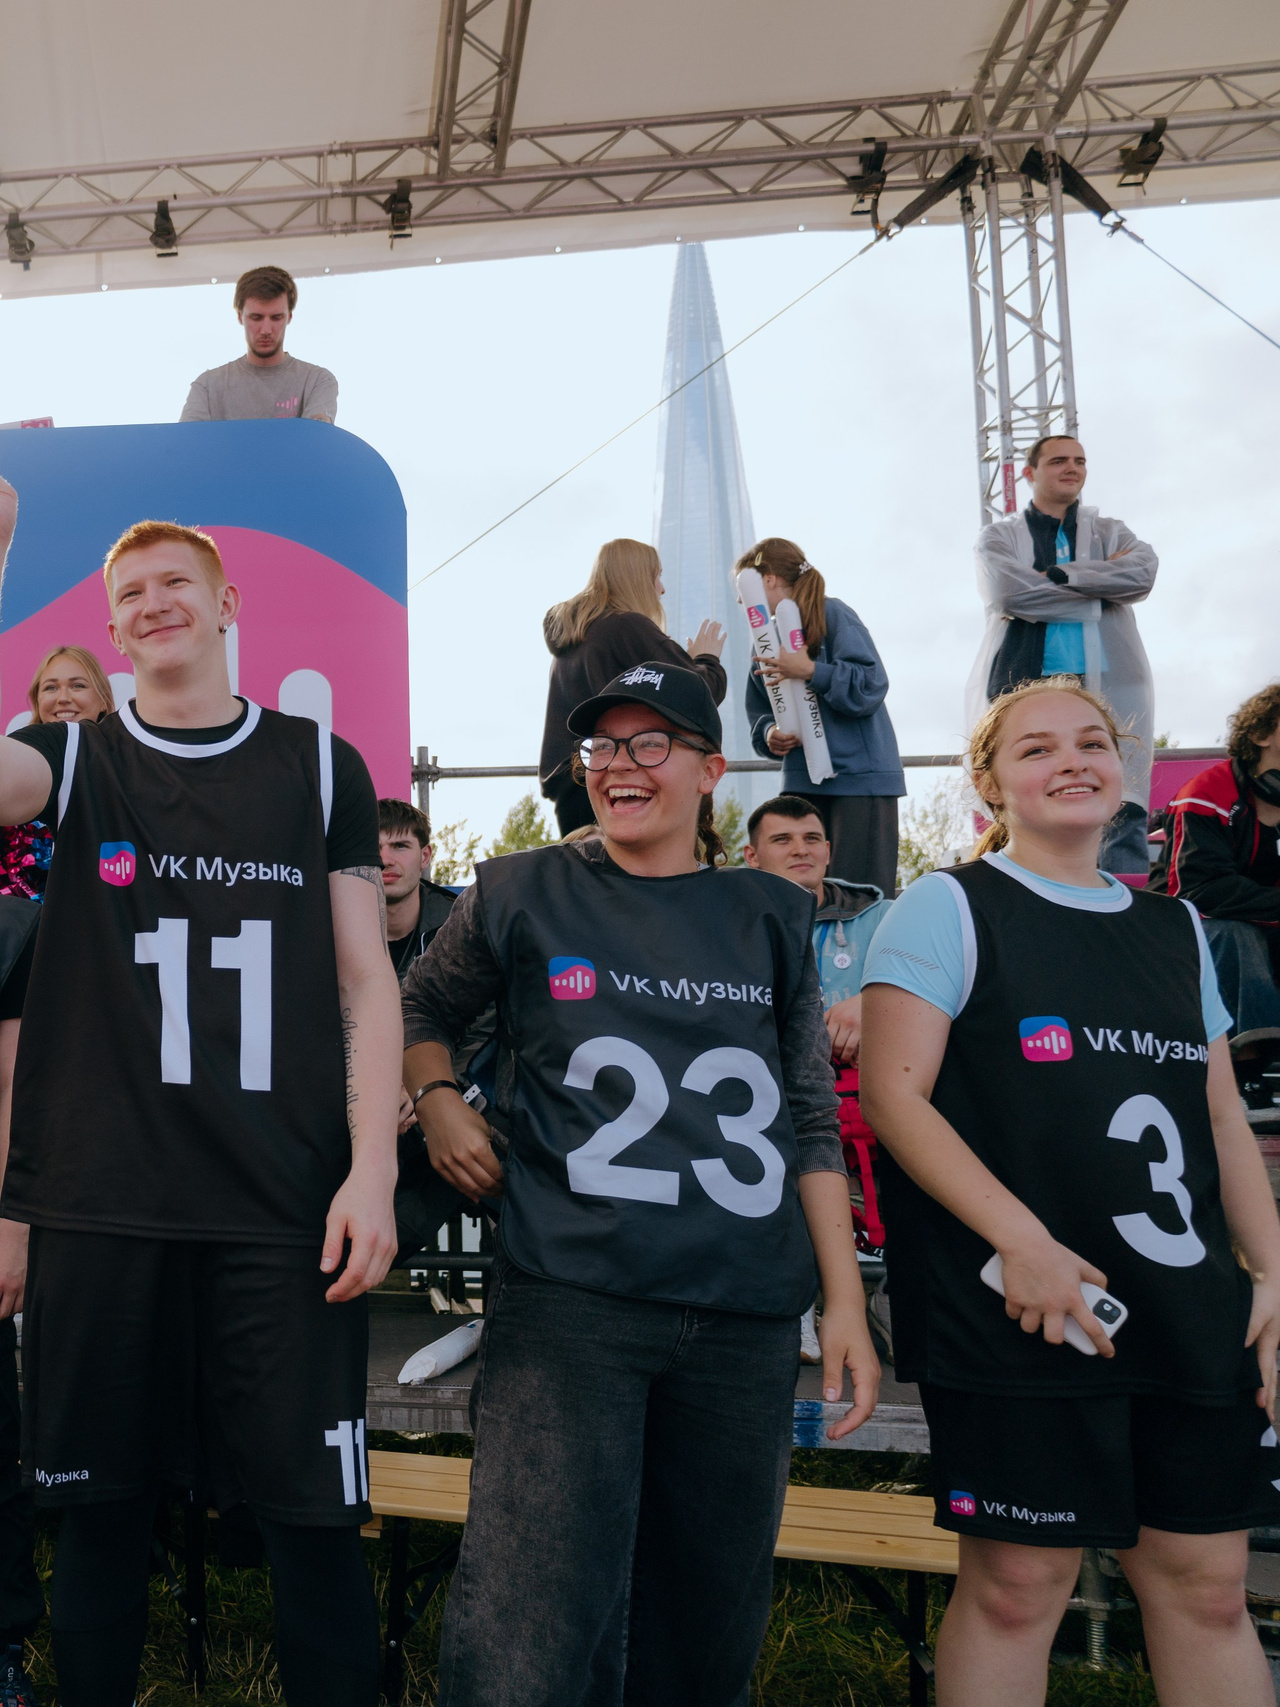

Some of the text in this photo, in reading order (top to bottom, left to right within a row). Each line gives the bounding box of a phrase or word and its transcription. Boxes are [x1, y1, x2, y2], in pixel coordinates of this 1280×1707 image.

[757, 632, 773, 654] VK
[148, 853, 303, 887] VK Музыка
[134, 917, 272, 1091] 11
[608, 970, 773, 1007] VK Музыка
[341, 1007, 358, 1079] Against
[1082, 1026, 1127, 1053] VK
[562, 1035, 786, 1218] 23
[1106, 1093, 1207, 1268] 3
[35, 1467, 89, 1487] Музыка
[324, 1418, 368, 1505] 11
[982, 1500, 1076, 1525] VK Музыка
